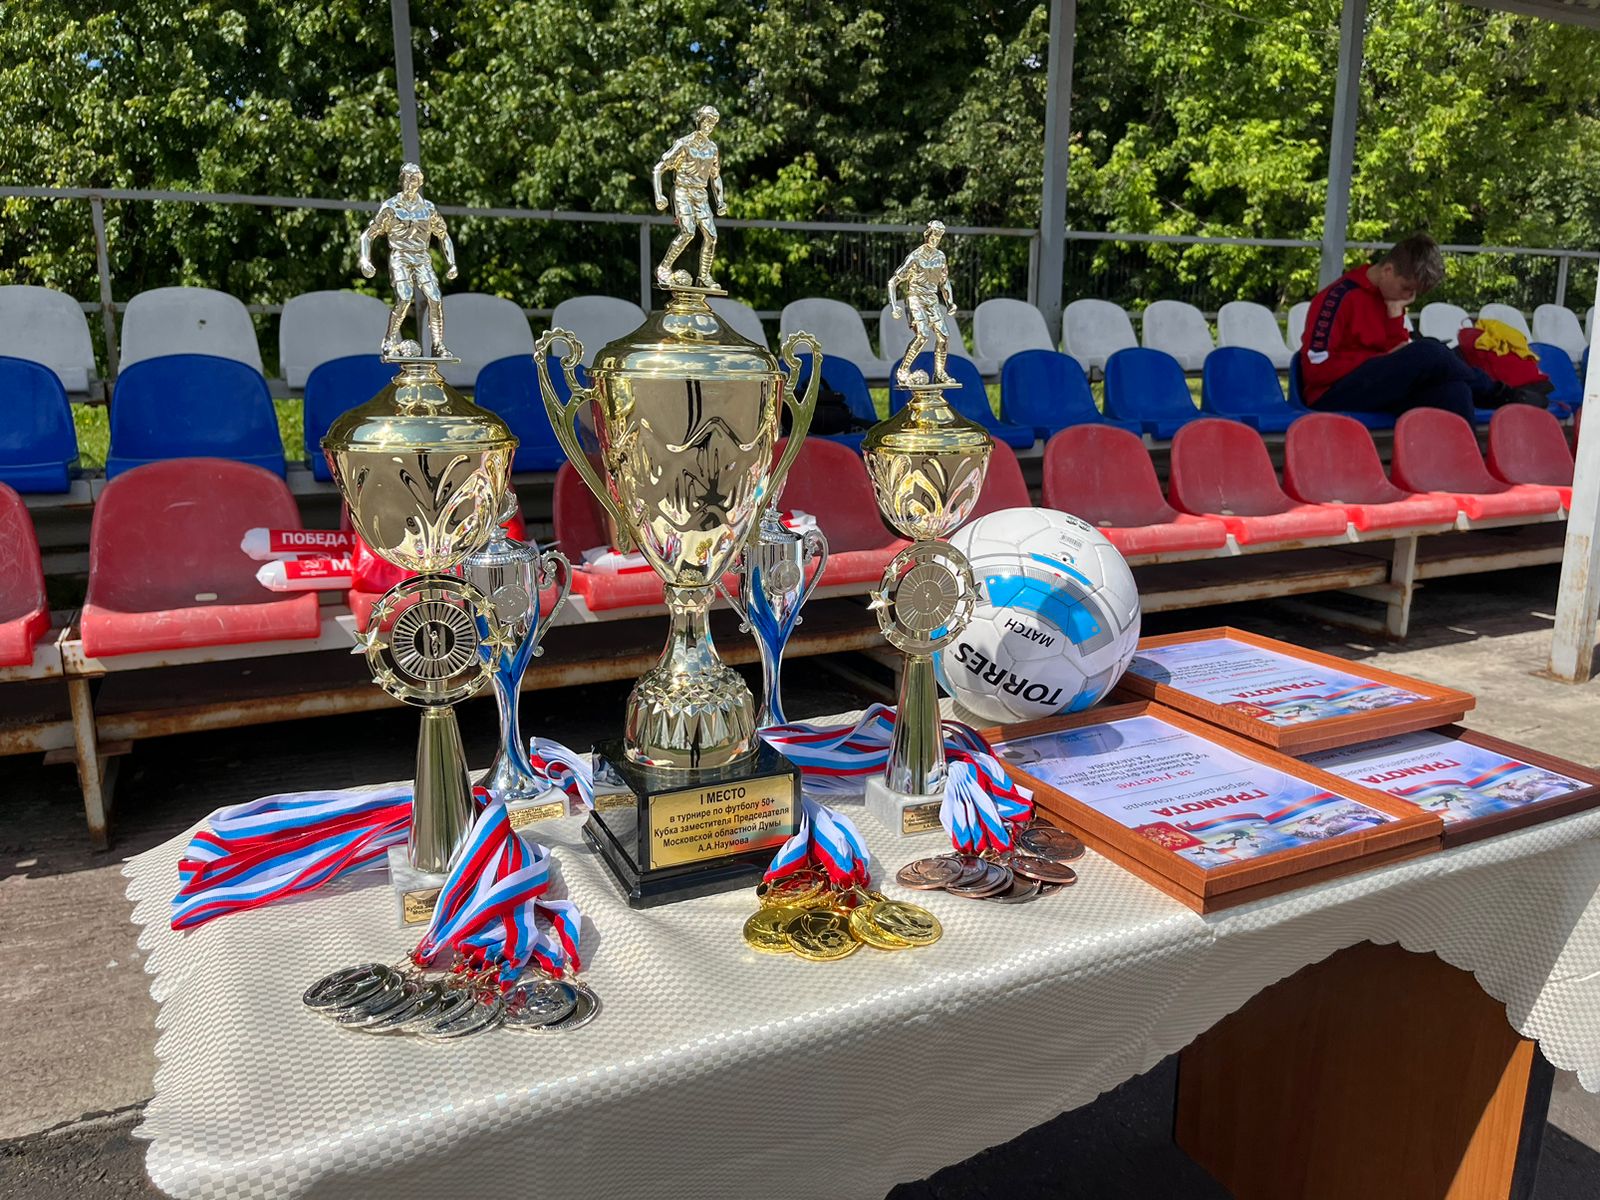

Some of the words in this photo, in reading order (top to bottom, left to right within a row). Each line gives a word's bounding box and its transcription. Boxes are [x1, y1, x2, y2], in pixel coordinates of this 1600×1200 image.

[282, 532, 347, 547] ПОБЕДА
[1004, 617, 1055, 648] MATCH
[954, 642, 1065, 706] TORRES
[1231, 680, 1326, 698] ГРАМОТА
[1116, 772, 1177, 790] участие
[1359, 758, 1462, 784] ГРАМОТА
[706, 787, 746, 804] МЕСТО
[1175, 781, 1253, 801] награждается
[677, 810, 711, 823] турнире
[712, 807, 723, 816] по
[725, 801, 759, 815] футболу
[761, 798, 775, 807] 50+
[1123, 797, 1175, 811] команда
[1150, 789, 1269, 817] ГРАМОТА
[654, 826, 678, 838] Кубка
[680, 818, 731, 833] заместителя
[733, 807, 789, 823] Председателя
[663, 832, 713, 848] Московской
[714, 825, 757, 838] областной
[758, 820, 781, 831] Думы
[698, 837, 749, 853] А.А.Наумова
